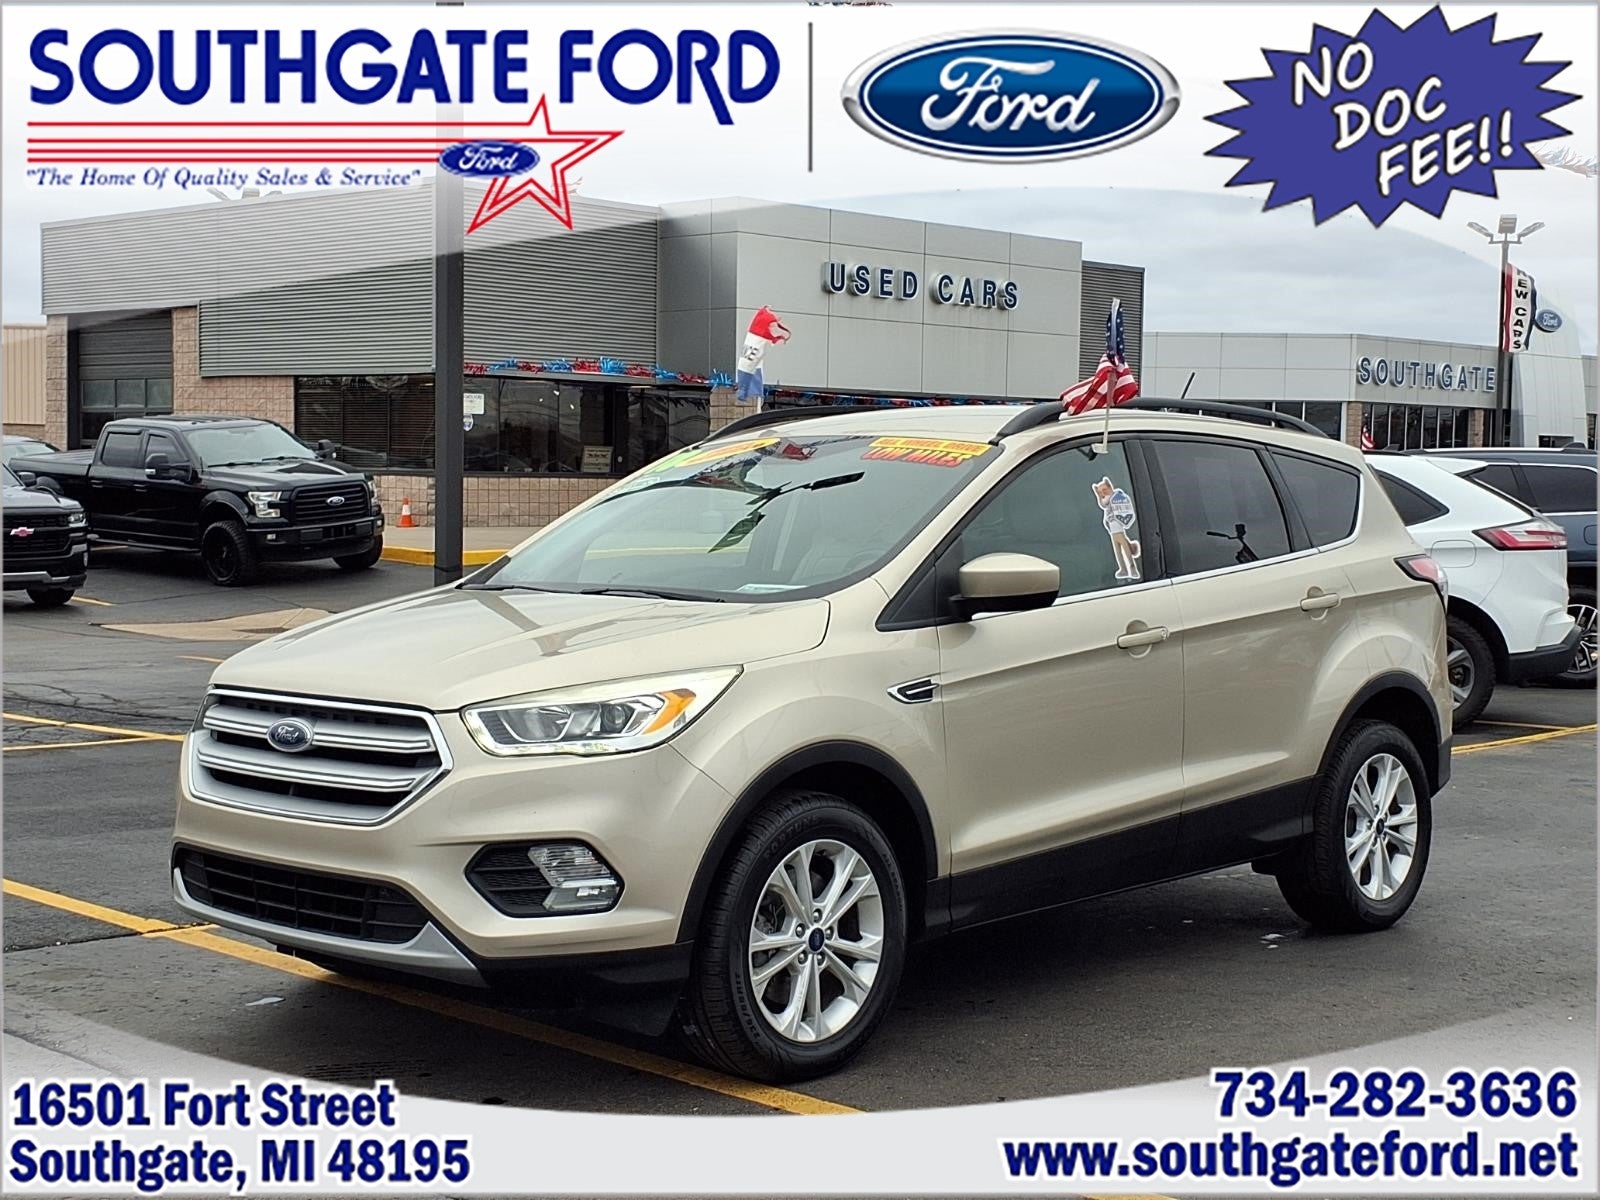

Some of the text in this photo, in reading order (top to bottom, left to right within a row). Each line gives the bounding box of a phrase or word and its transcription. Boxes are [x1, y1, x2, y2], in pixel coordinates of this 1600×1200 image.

[826, 261, 1019, 311] USED CARS
[1512, 306, 1528, 350] CARS
[1358, 355, 1496, 393] SOUTHGATE
[862, 447, 974, 469] LOW MILES
[275, 725, 300, 743] Ford
